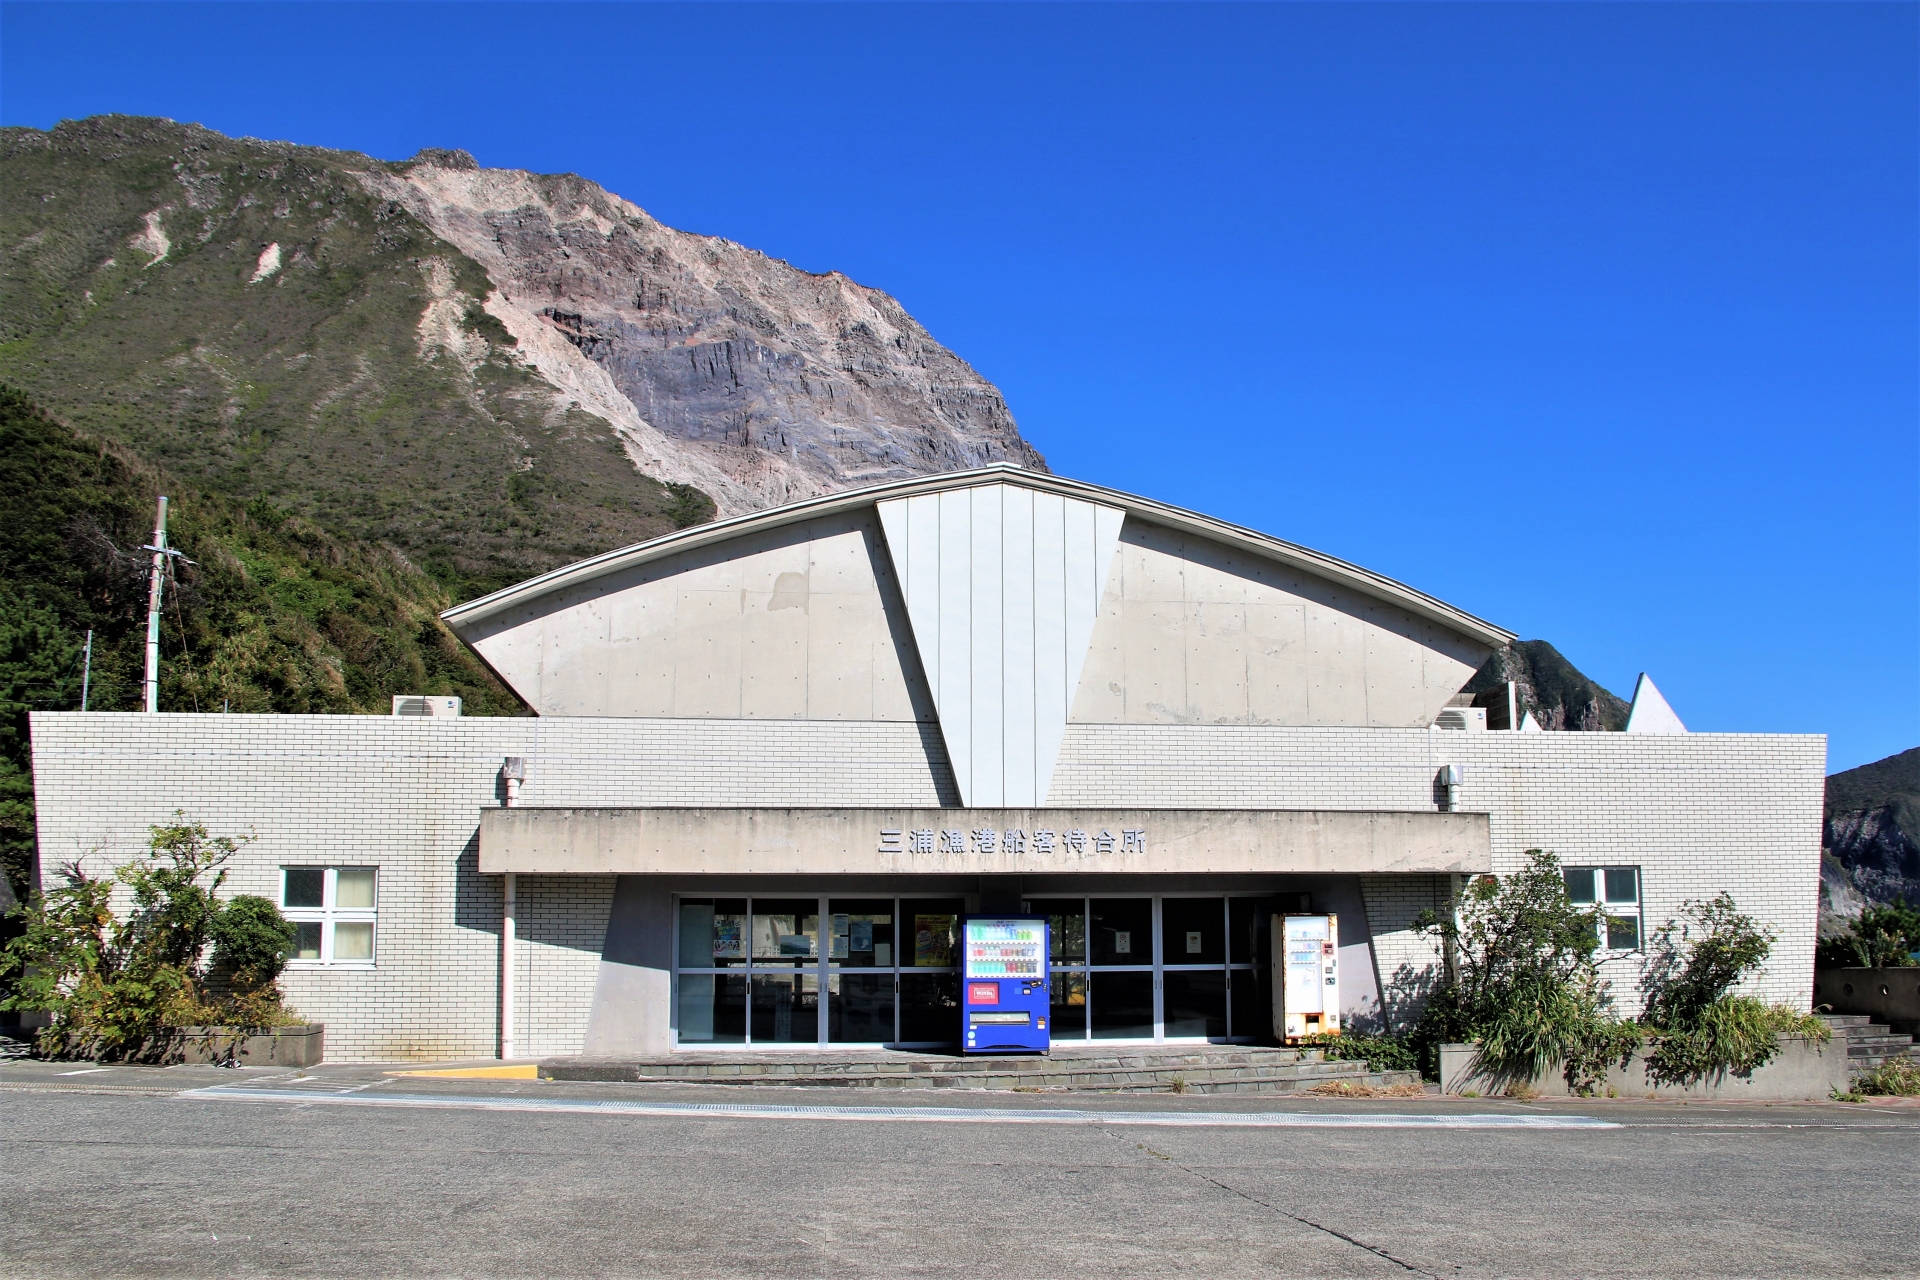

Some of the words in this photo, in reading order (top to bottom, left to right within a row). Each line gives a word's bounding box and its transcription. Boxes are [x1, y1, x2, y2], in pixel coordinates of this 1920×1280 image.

[879, 828, 1146, 854] 三浦漁港船客待合所
